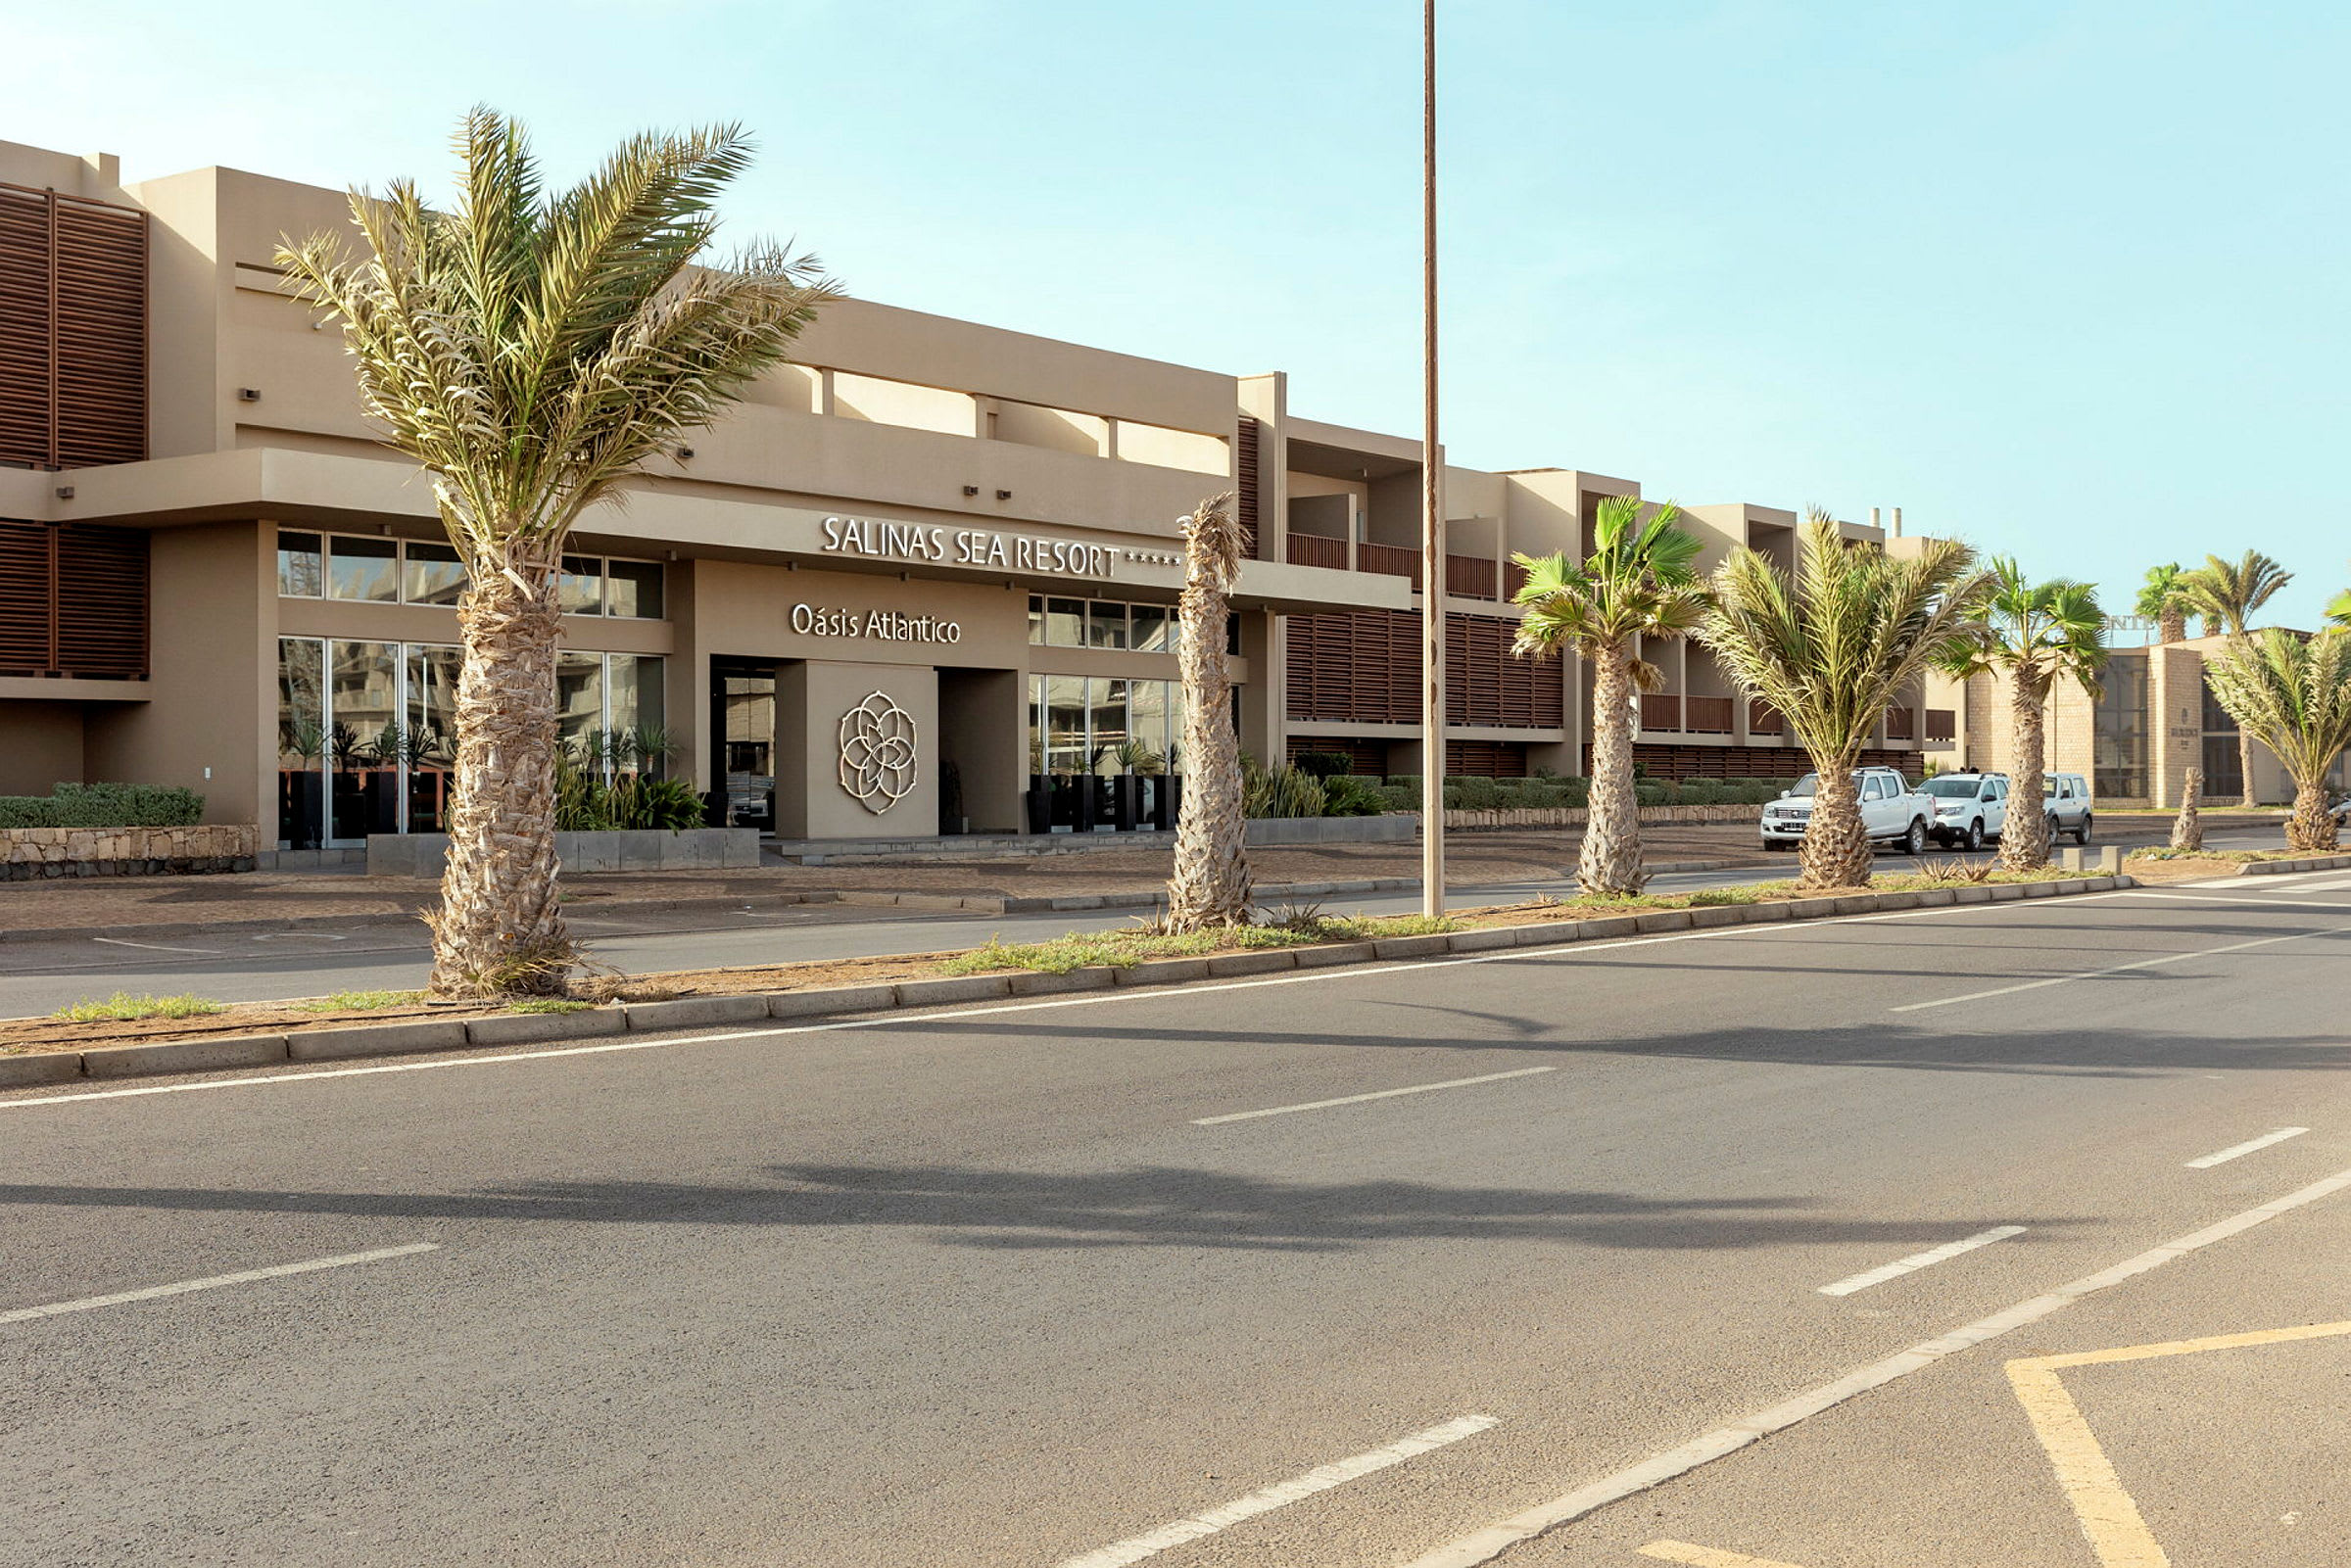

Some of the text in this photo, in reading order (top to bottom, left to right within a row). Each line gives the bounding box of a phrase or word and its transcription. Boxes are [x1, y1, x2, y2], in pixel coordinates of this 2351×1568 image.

[822, 516, 1121, 578] SALINAS SEA RESORT
[791, 602, 962, 644] Oásis Atlantico
